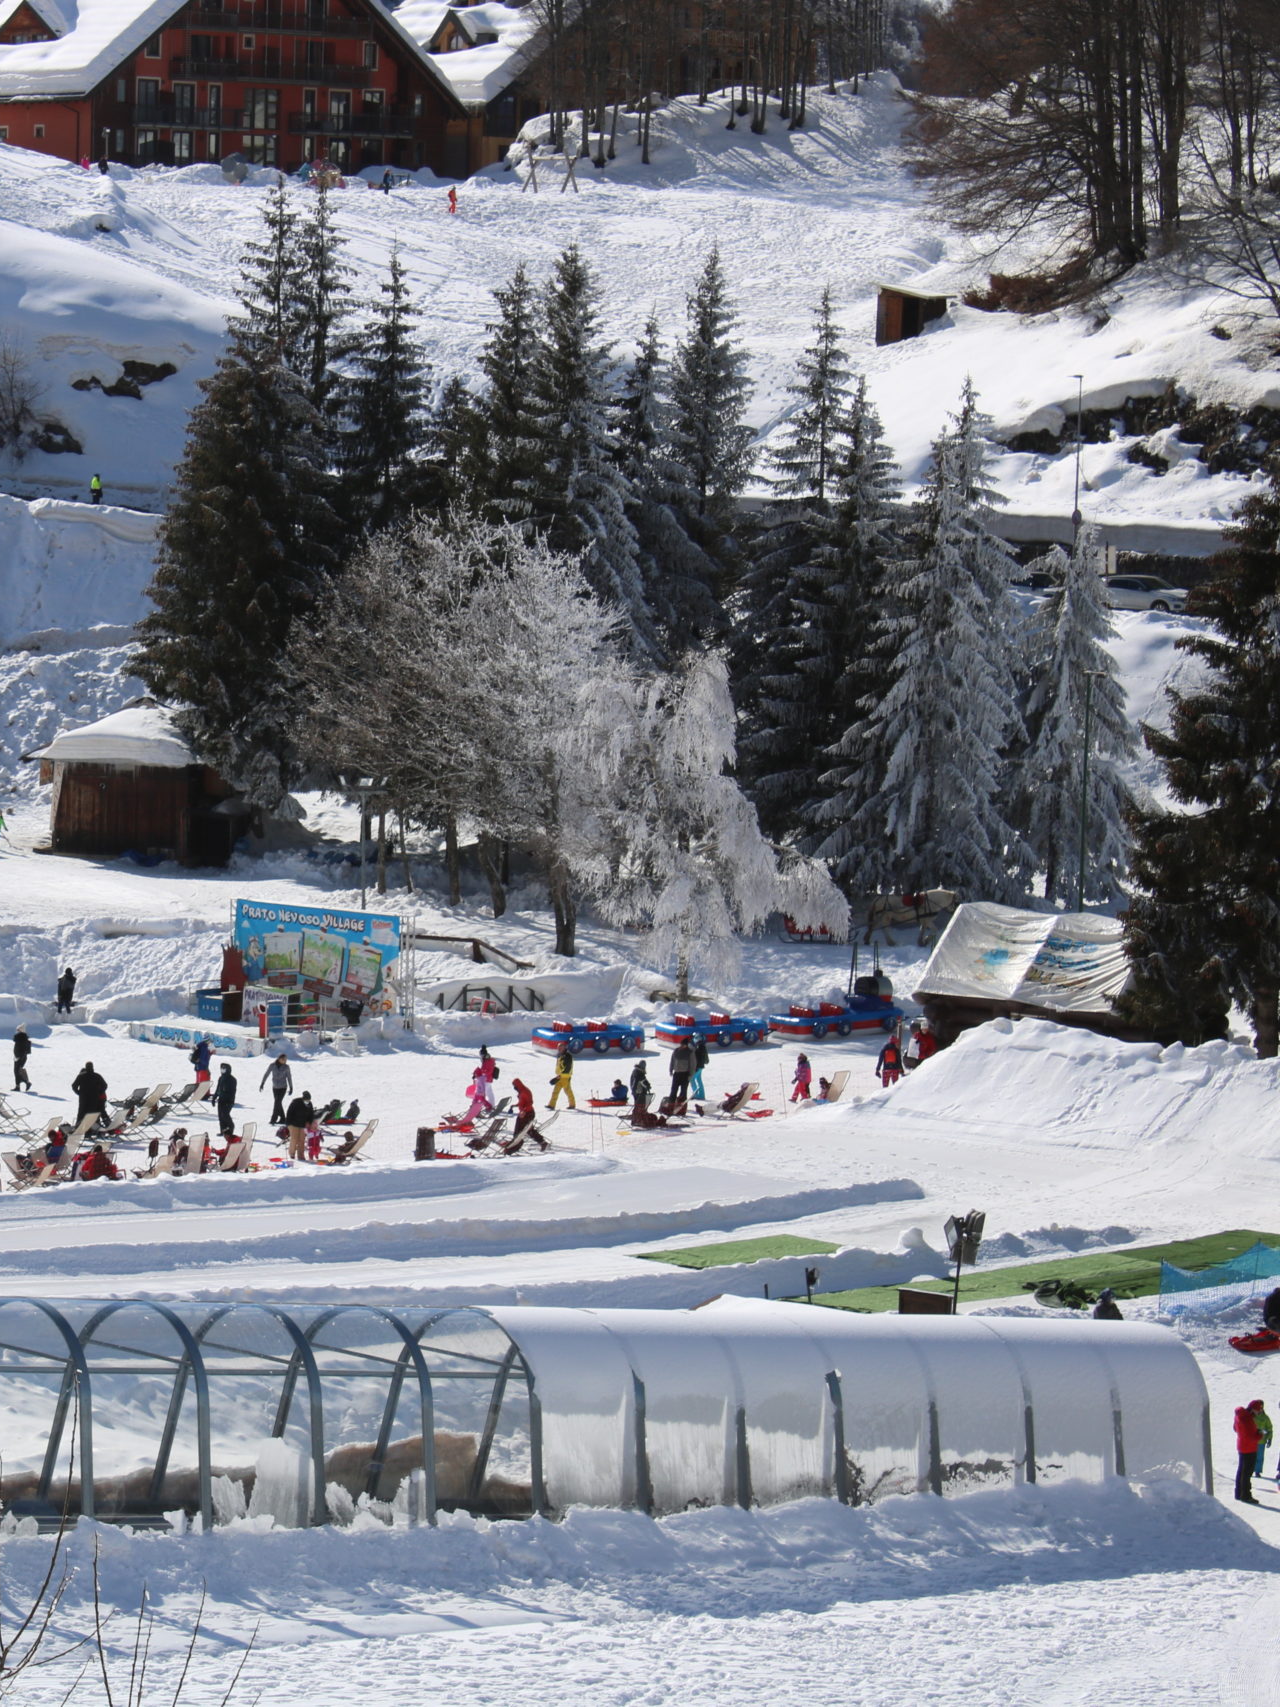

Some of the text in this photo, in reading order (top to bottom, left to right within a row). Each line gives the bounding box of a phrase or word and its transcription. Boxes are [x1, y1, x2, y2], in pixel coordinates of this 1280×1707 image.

[242, 904, 276, 921] PRATO
[278, 909, 320, 926] NEVOSO
[321, 914, 365, 932] VILLAGE
